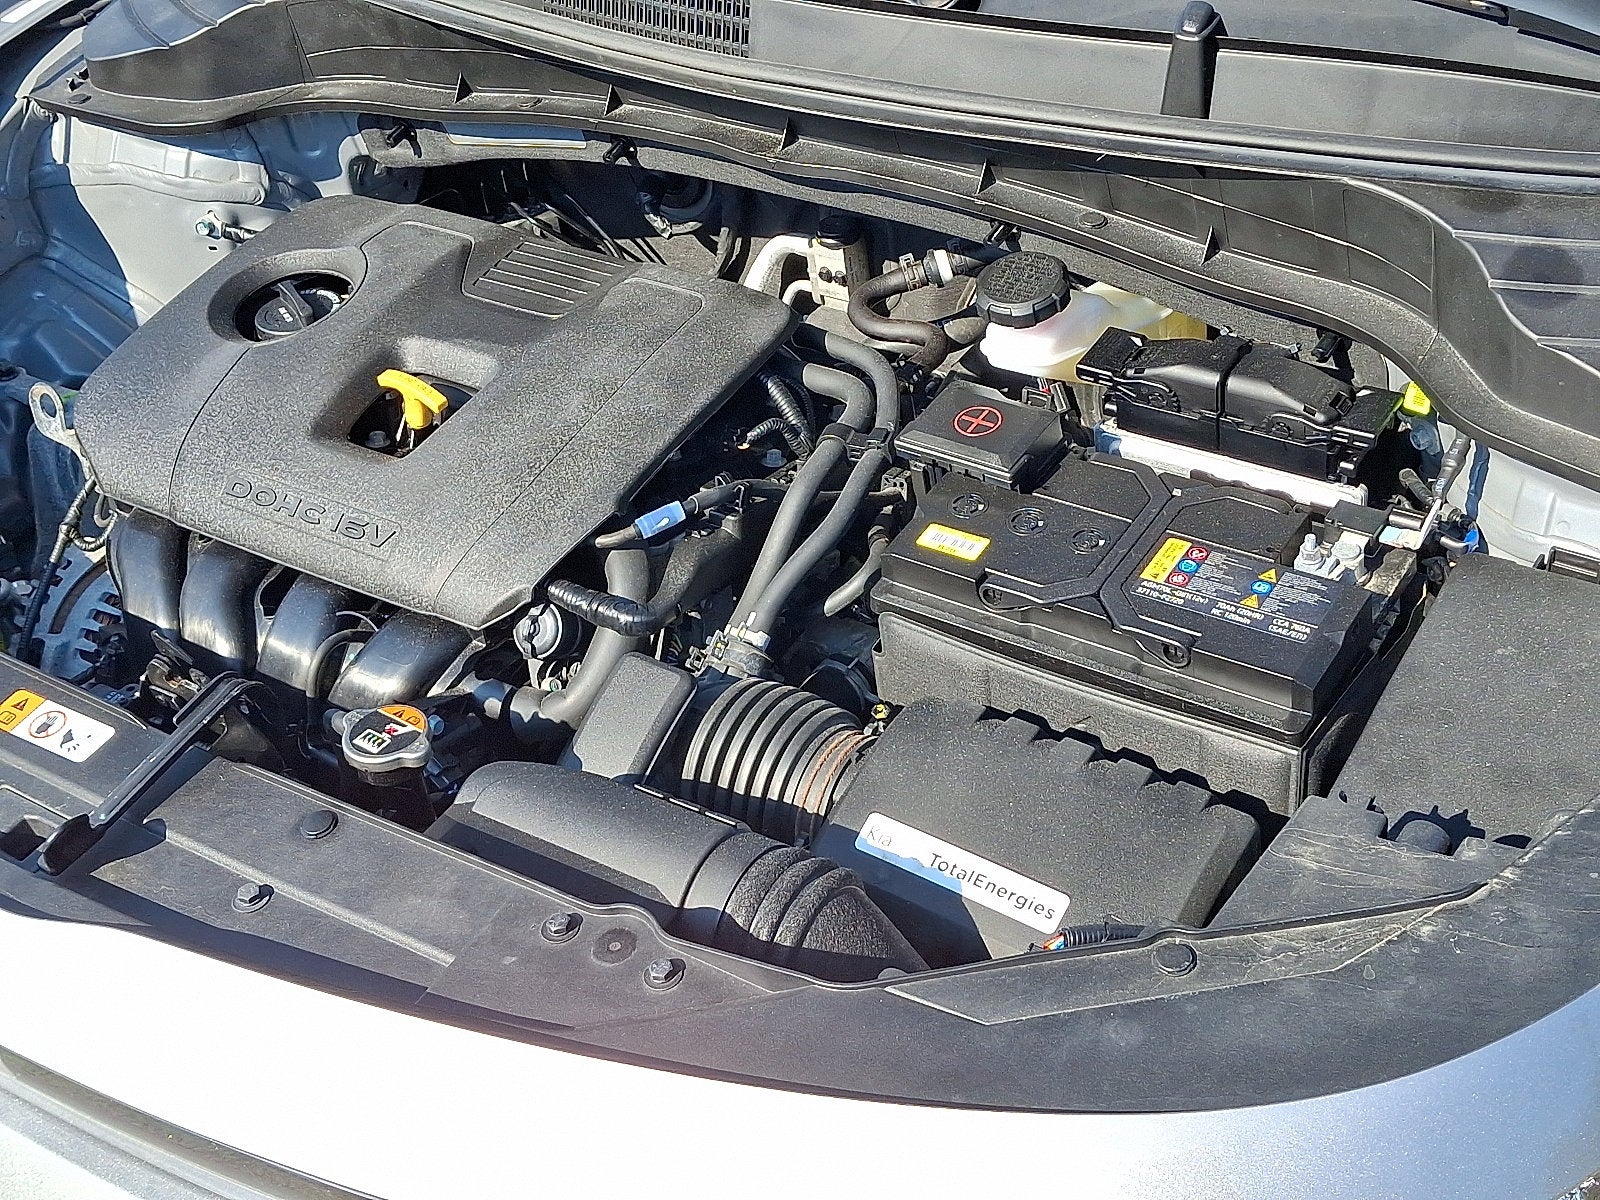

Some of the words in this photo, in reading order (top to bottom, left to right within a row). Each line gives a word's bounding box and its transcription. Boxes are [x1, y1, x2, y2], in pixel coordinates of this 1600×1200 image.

[224, 475, 326, 525] DOHC
[330, 512, 397, 548] 16V
[1210, 607, 1224, 617] RC
[1272, 618, 1289, 628] CCA
[866, 825, 892, 847] Kia
[929, 852, 1056, 920] TotalEnergies
